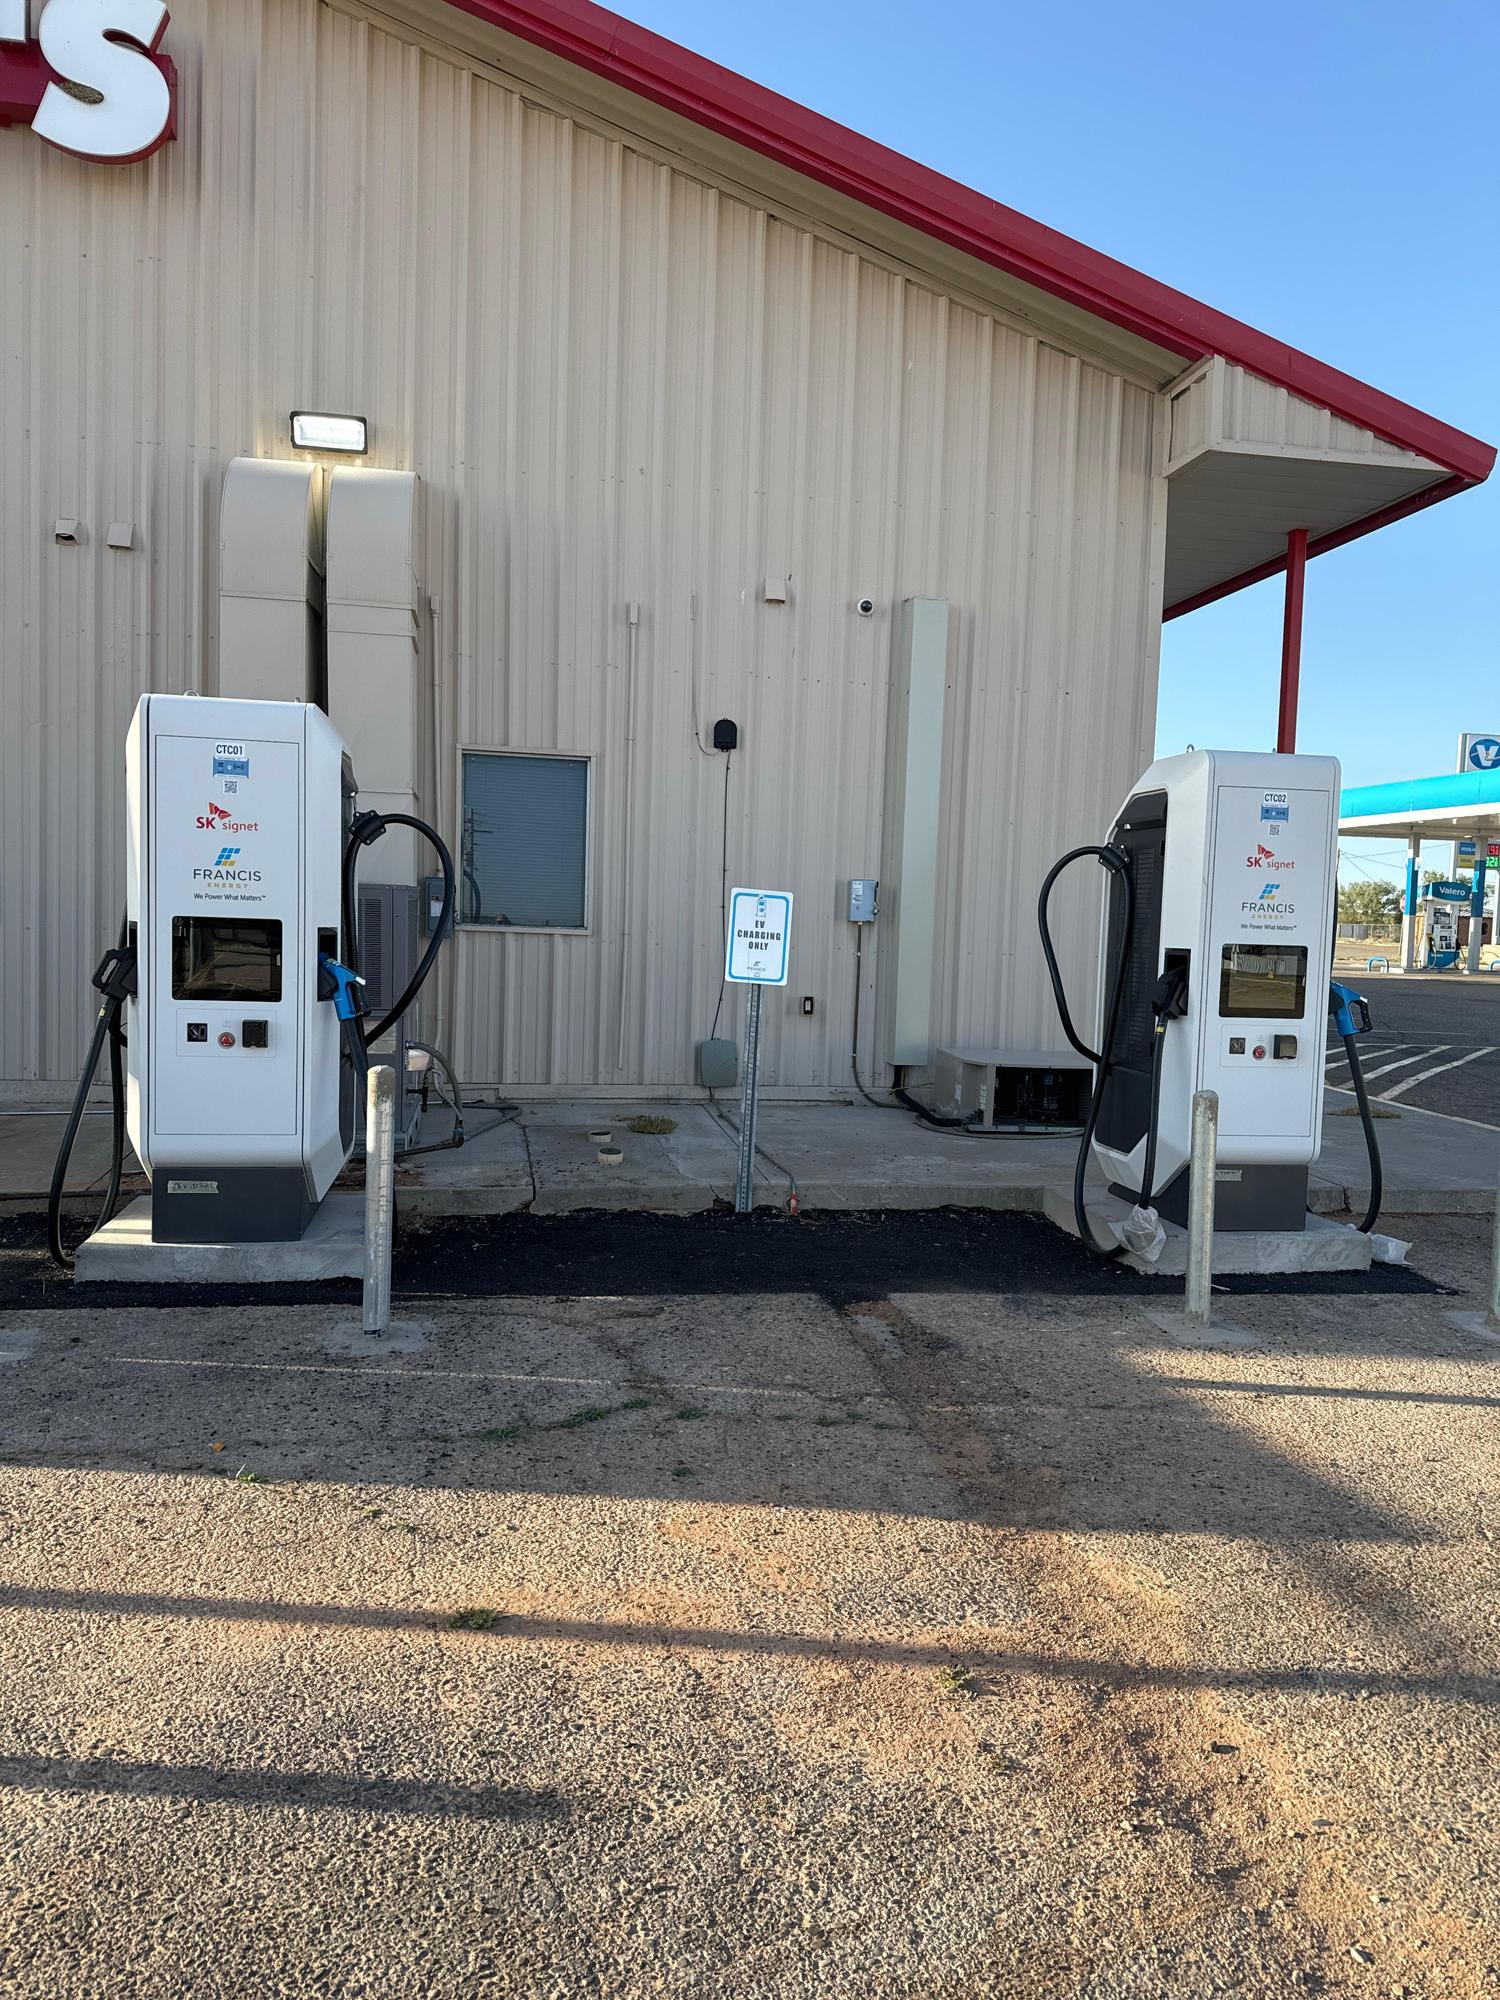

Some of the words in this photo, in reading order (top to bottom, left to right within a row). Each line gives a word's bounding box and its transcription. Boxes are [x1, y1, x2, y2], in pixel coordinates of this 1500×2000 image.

[216, 744, 243, 755] CTC01
[1264, 793, 1287, 803] CTC02
[196, 816, 216, 830] SK
[222, 820, 259, 833] signet
[1246, 857, 1263, 868] SK
[1267, 860, 1295, 871] signet
[193, 868, 262, 882] FRANCIS
[193, 892, 204, 900] We
[204, 893, 223, 901] Power
[224, 893, 240, 901] What
[1439, 886, 1466, 897] Valero
[1241, 902, 1295, 914] FRANCIS
[755, 920, 765, 929] EV
[737, 929, 781, 941] CHARGING
[748, 941, 769, 951] ONLY
